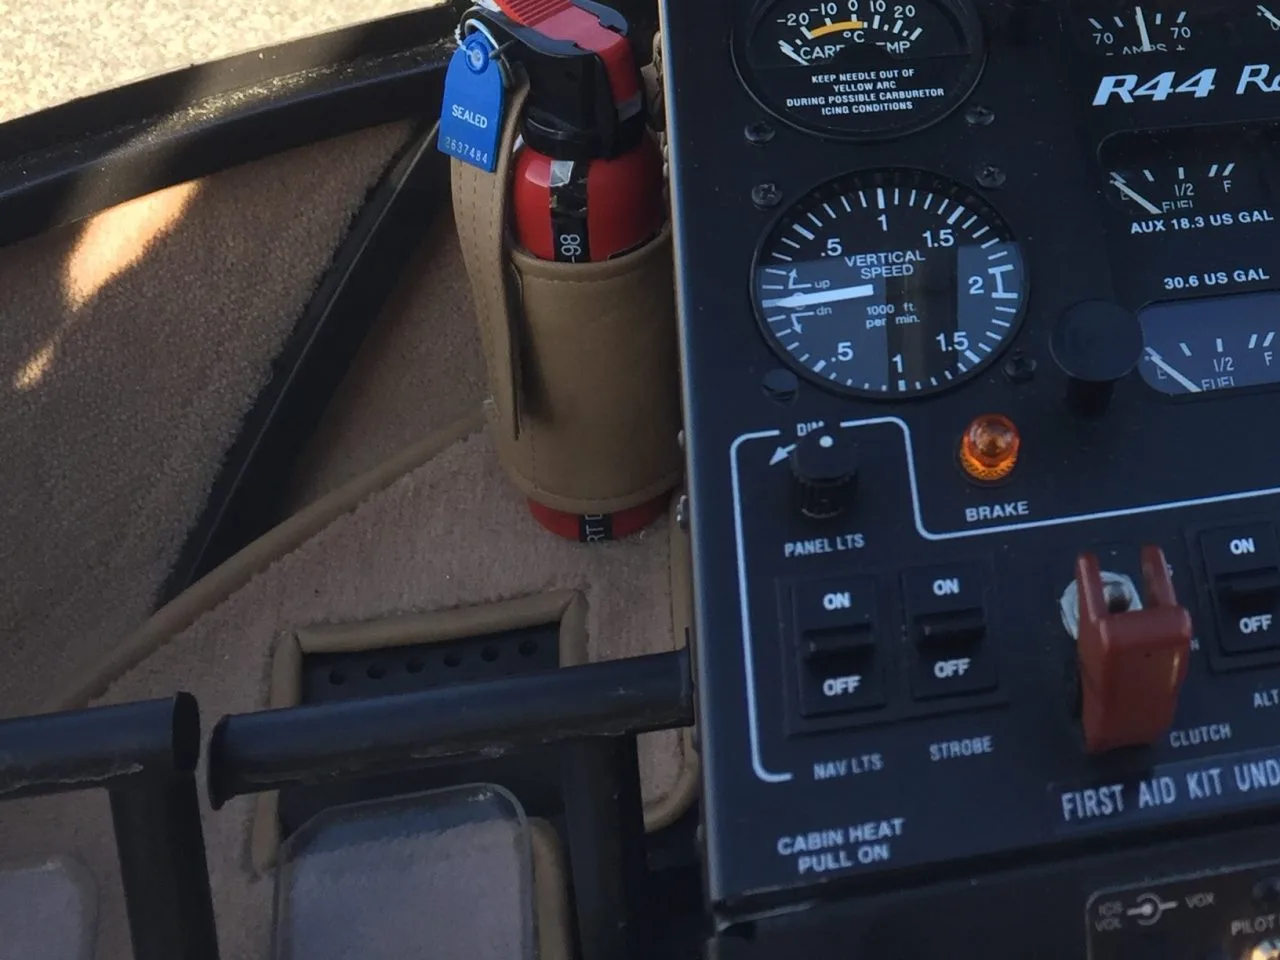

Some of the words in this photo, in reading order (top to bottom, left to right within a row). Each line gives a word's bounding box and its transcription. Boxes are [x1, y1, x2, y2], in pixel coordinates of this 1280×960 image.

[894, 5, 916, 18] 20
[843, 30, 865, 43] °C
[812, 74, 836, 84] KEEP
[840, 71, 876, 82] NEEDLE
[879, 70, 899, 79] OUT
[902, 69, 915, 77] OF
[833, 81, 874, 93] YELLOW
[876, 80, 897, 89] ARC
[1092, 68, 1216, 106] R44
[786, 97, 825, 107] DURING
[828, 94, 876, 105] POSSIBLE
[879, 88, 945, 100] CARBURETOR
[451, 103, 488, 130] SEALED
[822, 106, 849, 115] ICING
[852, 101, 913, 114] CONDITIONS
[444, 136, 490, 164] 2637484
[1131, 219, 1166, 234] AUX
[1171, 215, 1204, 230] 18.3
[1209, 213, 1233, 226] US
[1238, 209, 1274, 223] GAL
[922, 229, 955, 248] 1.5
[844, 249, 926, 267] VERTICAL
[860, 264, 914, 280] SPEED
[1164, 275, 1199, 290] 30.6
[1204, 272, 1228, 285] US
[1233, 268, 1270, 282] GAL
[815, 278, 830, 290] up
[816, 304, 832, 316] dn
[866, 317, 886, 329] per
[936, 332, 969, 352] 1.5
[965, 501, 1029, 522] BRAKE
[784, 539, 834, 557] PANEL
[837, 534, 865, 551] LTS
[1229, 537, 1255, 555] ON
[933, 578, 960, 595] ON
[823, 592, 850, 610] ON
[1239, 614, 1272, 634] OFF
[934, 658, 970, 678] OFF
[823, 676, 862, 695] OFF
[1252, 688, 1279, 708] ALT
[1169, 722, 1232, 748] CLUTCH
[929, 736, 994, 761] STROBE
[813, 759, 848, 780] NAV
[851, 753, 884, 773] LTS
[1061, 784, 1124, 821] FIRST
[1138, 776, 1176, 808] AID
[1186, 768, 1223, 800] KIT
[777, 828, 844, 855] CABIN
[848, 817, 905, 844] HEAT
[797, 850, 852, 875] PULL
[857, 844, 889, 863] ON
[1231, 914, 1275, 936] PILOT
